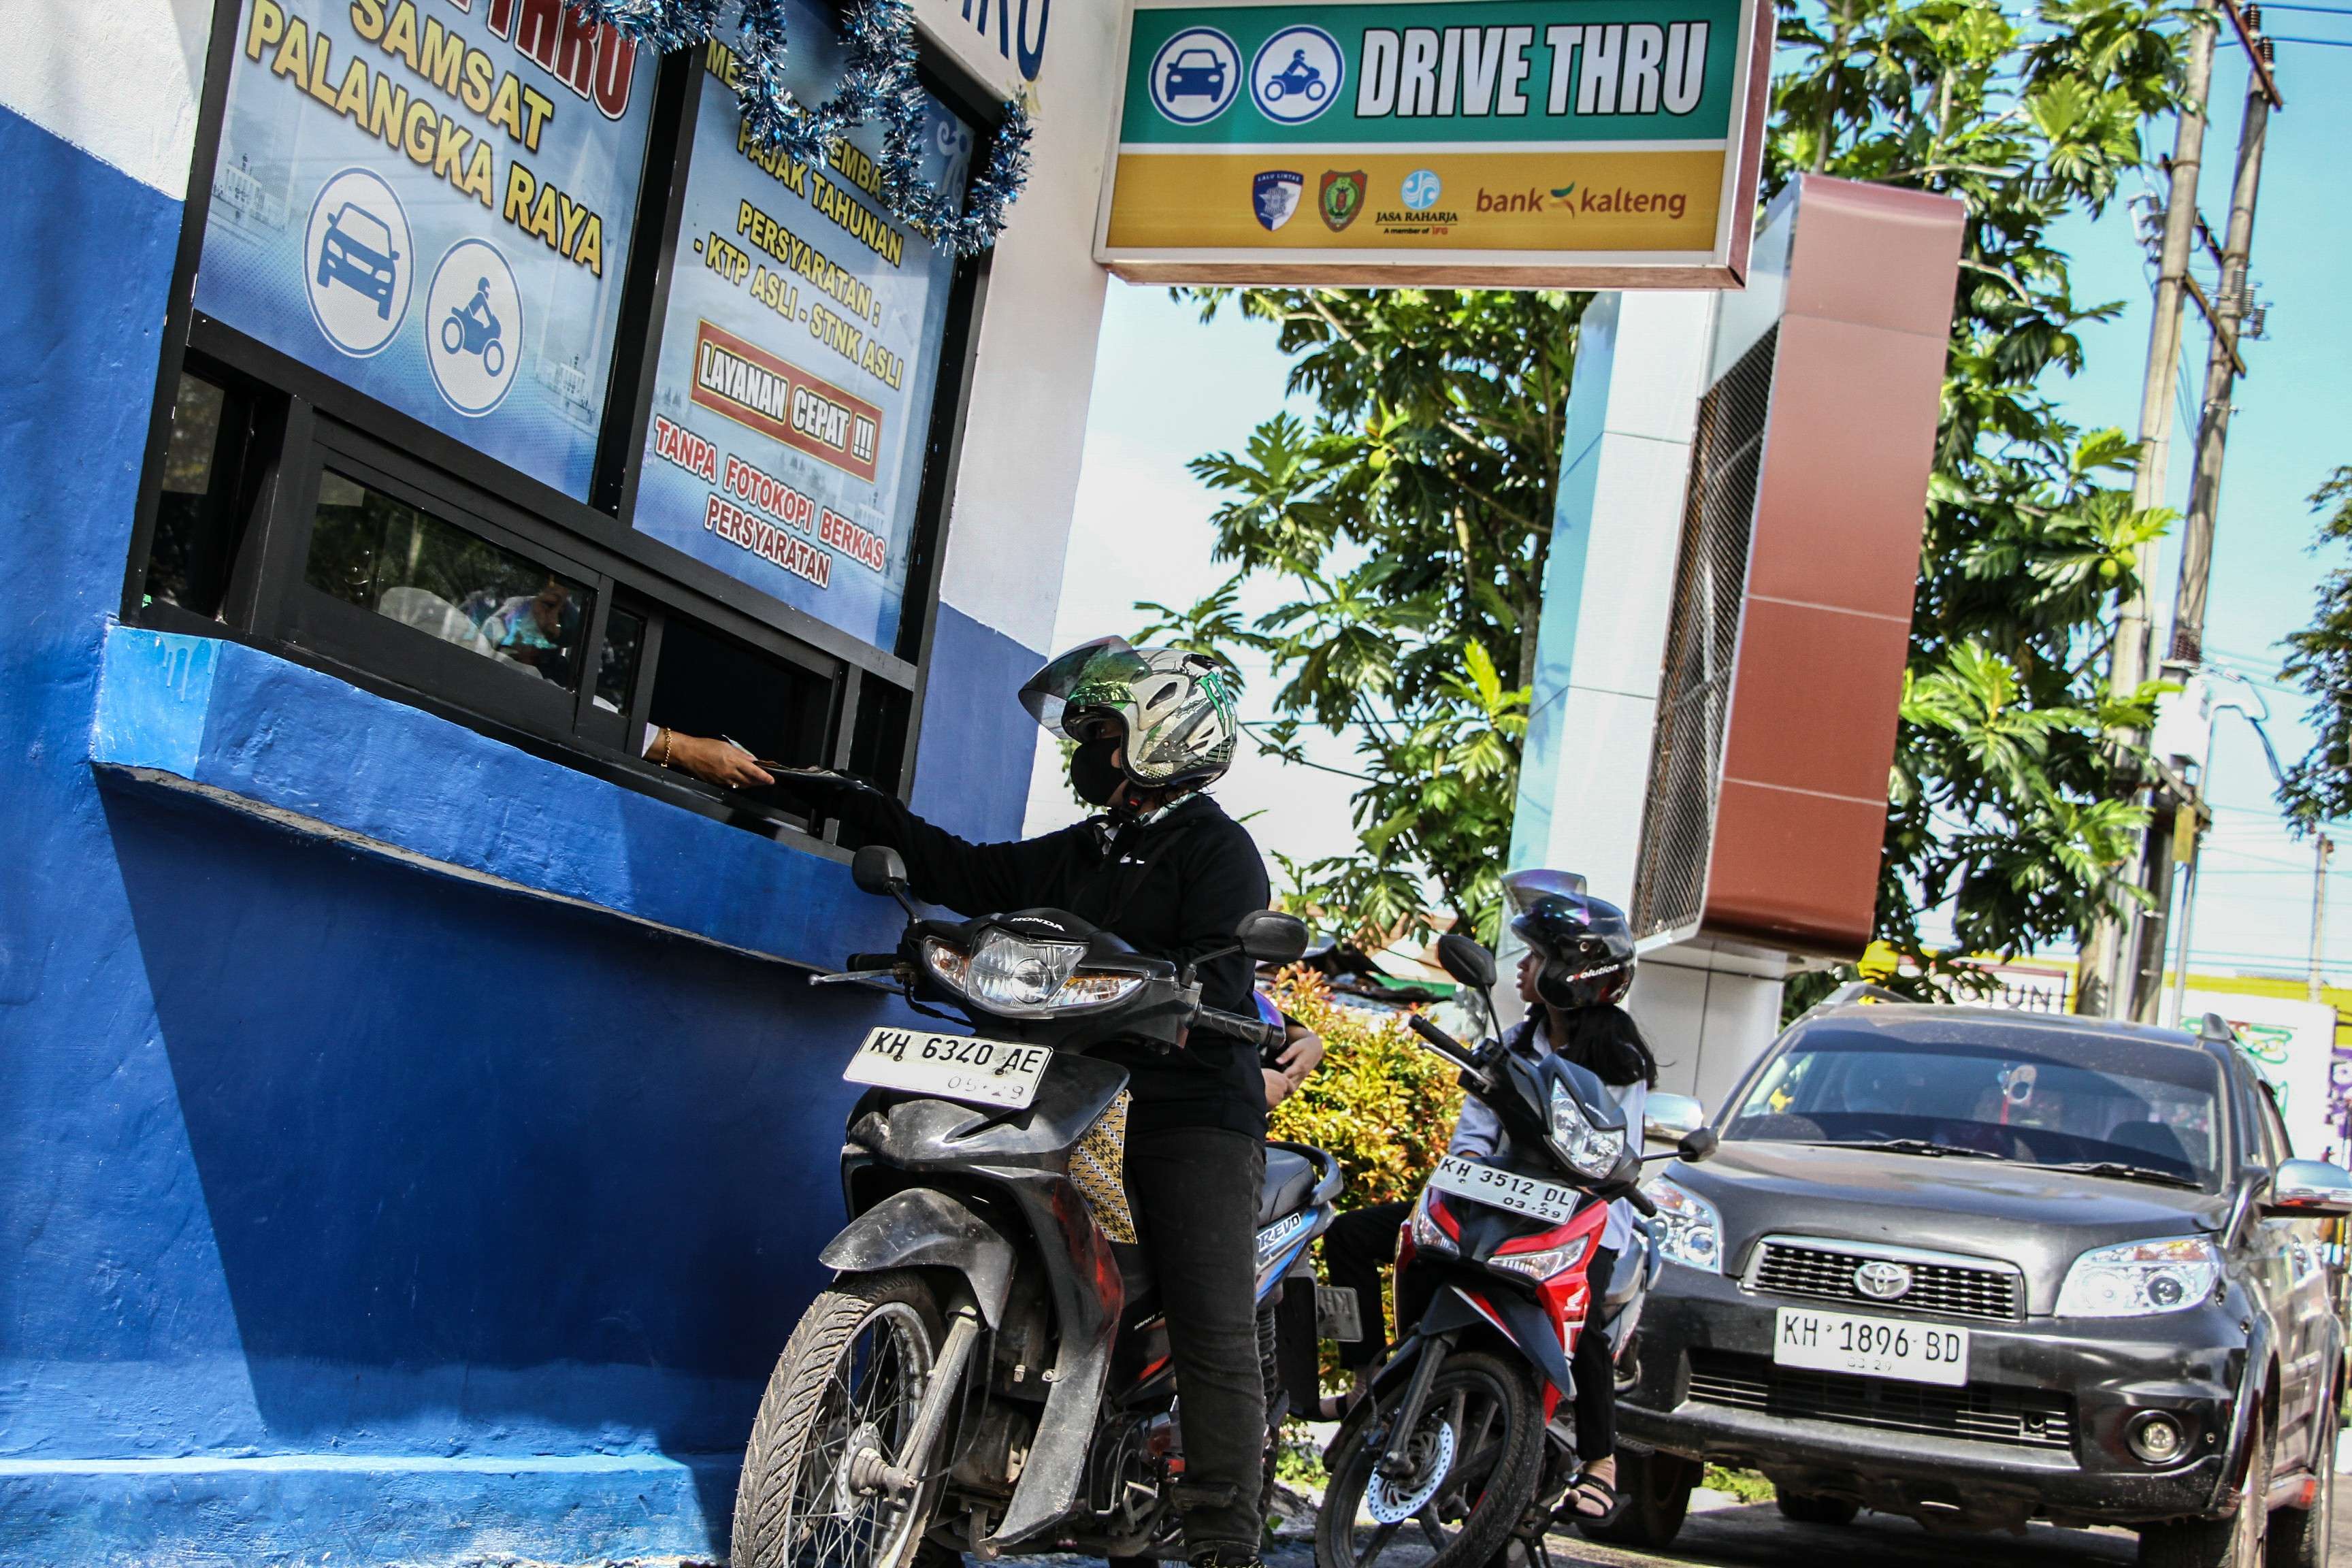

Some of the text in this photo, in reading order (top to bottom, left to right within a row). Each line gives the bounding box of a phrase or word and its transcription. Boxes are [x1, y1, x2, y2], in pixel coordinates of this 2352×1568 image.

[350, 0, 555, 153] SAMSAT
[1355, 20, 1711, 118] DRIVE THRU
[246, 0, 603, 278] PALANGKA RAYA
[1257, 173, 1300, 182] LALU LINTAS
[1476, 186, 1686, 220] bank kalteng
[811, 170, 904, 268] TAHUNAN
[1375, 212, 1458, 223] JASA RAHARJA
[737, 199, 872, 321] PERSYARATAN
[706, 232, 750, 287] KTP
[751, 264, 798, 322] ASLI
[810, 302, 862, 365] STNK
[862, 339, 904, 391] ASLI
[698, 342, 877, 464] LAYANAN CEPAT !!!
[655, 414, 886, 572] TANPA FOTOKOPI BERKAS
[704, 493, 832, 589] PERSYARATAN
[1010, 917, 1065, 932] HONDA
[1566, 964, 1620, 983] evolution
[870, 1030, 1043, 1073] KH 6340 AE
[1440, 1158, 1569, 1206] KH 3512 DL
[1256, 1212, 1301, 1253] REVO
[1784, 1315, 1960, 1363] KH 1896 BD
